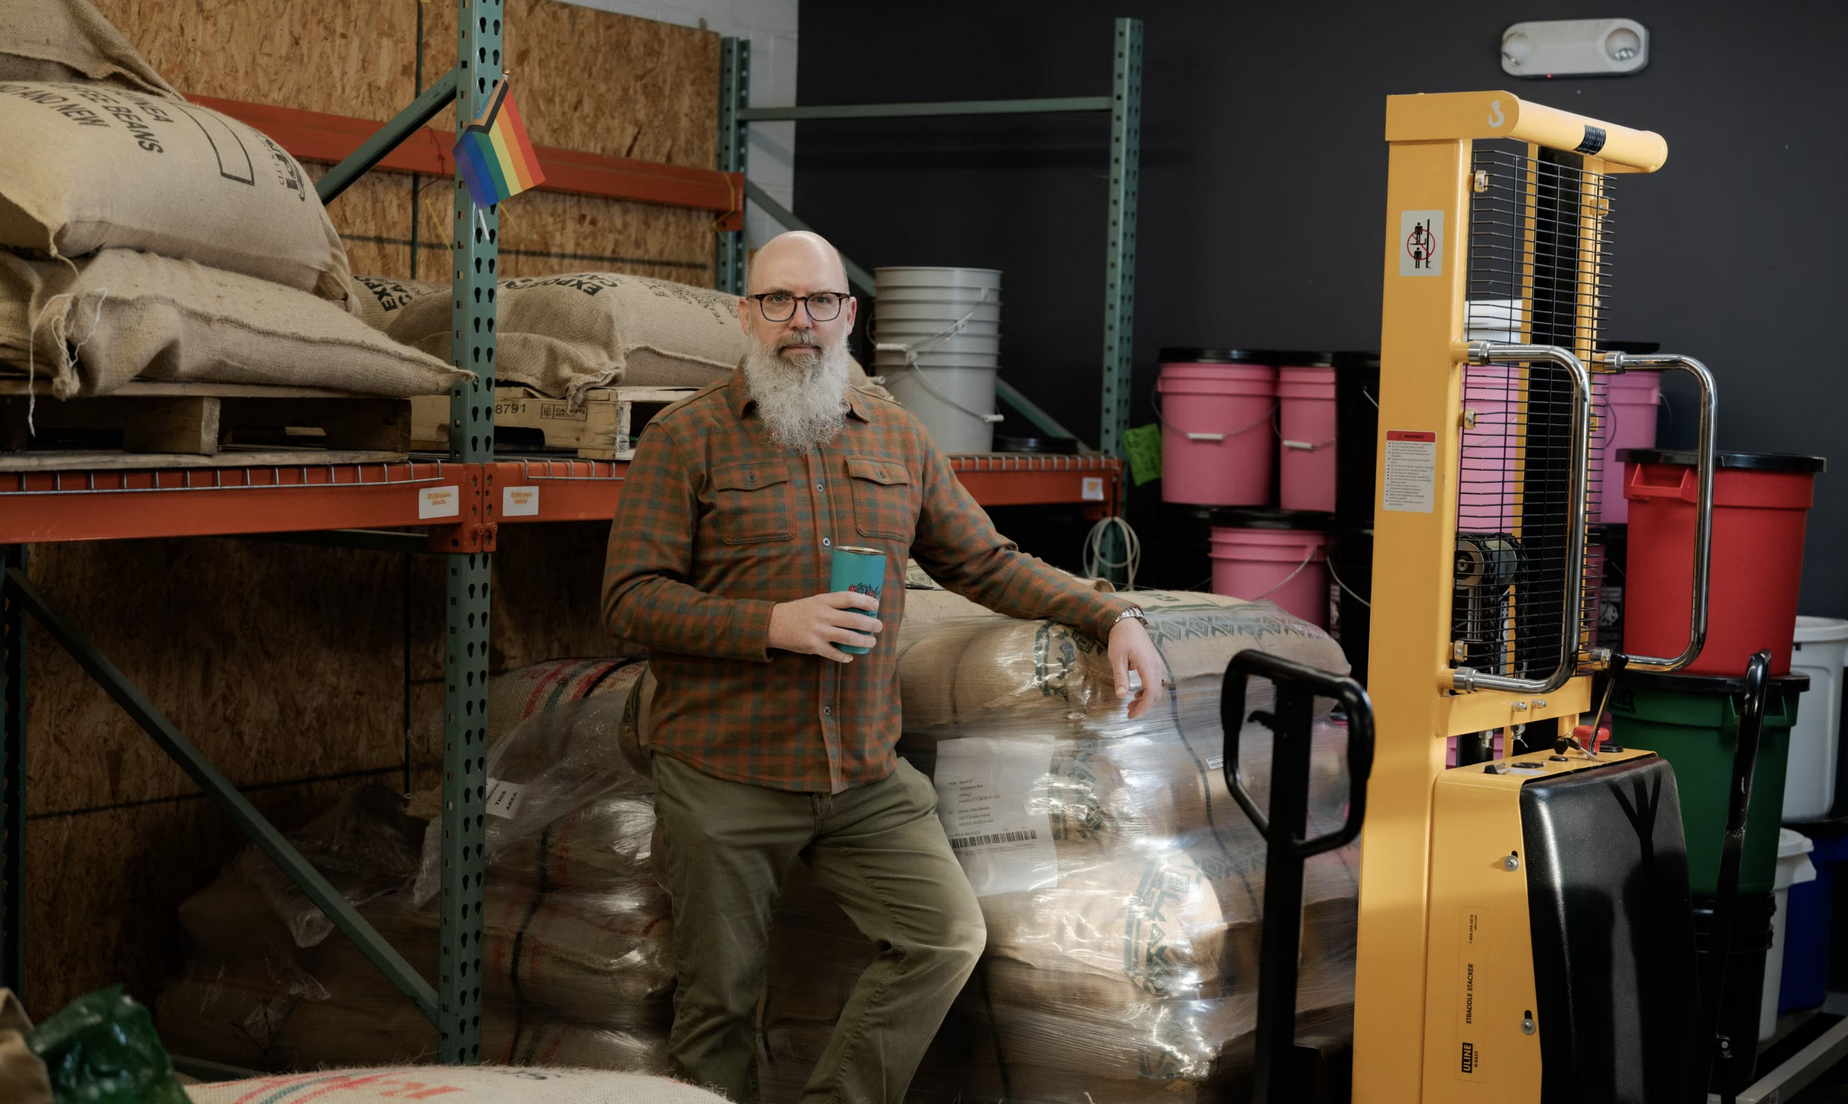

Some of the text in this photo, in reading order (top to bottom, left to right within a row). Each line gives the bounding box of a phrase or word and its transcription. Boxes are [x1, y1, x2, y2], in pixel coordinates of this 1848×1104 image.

[50, 103, 111, 127] NEW
[102, 105, 164, 154] BEANS
[495, 403, 526, 415] 8791
[494, 790, 507, 806] THIS
[505, 792, 518, 810] AREA
[1465, 992, 1473, 1024] STRADDLE
[1462, 1043, 1472, 1072] ULINE
